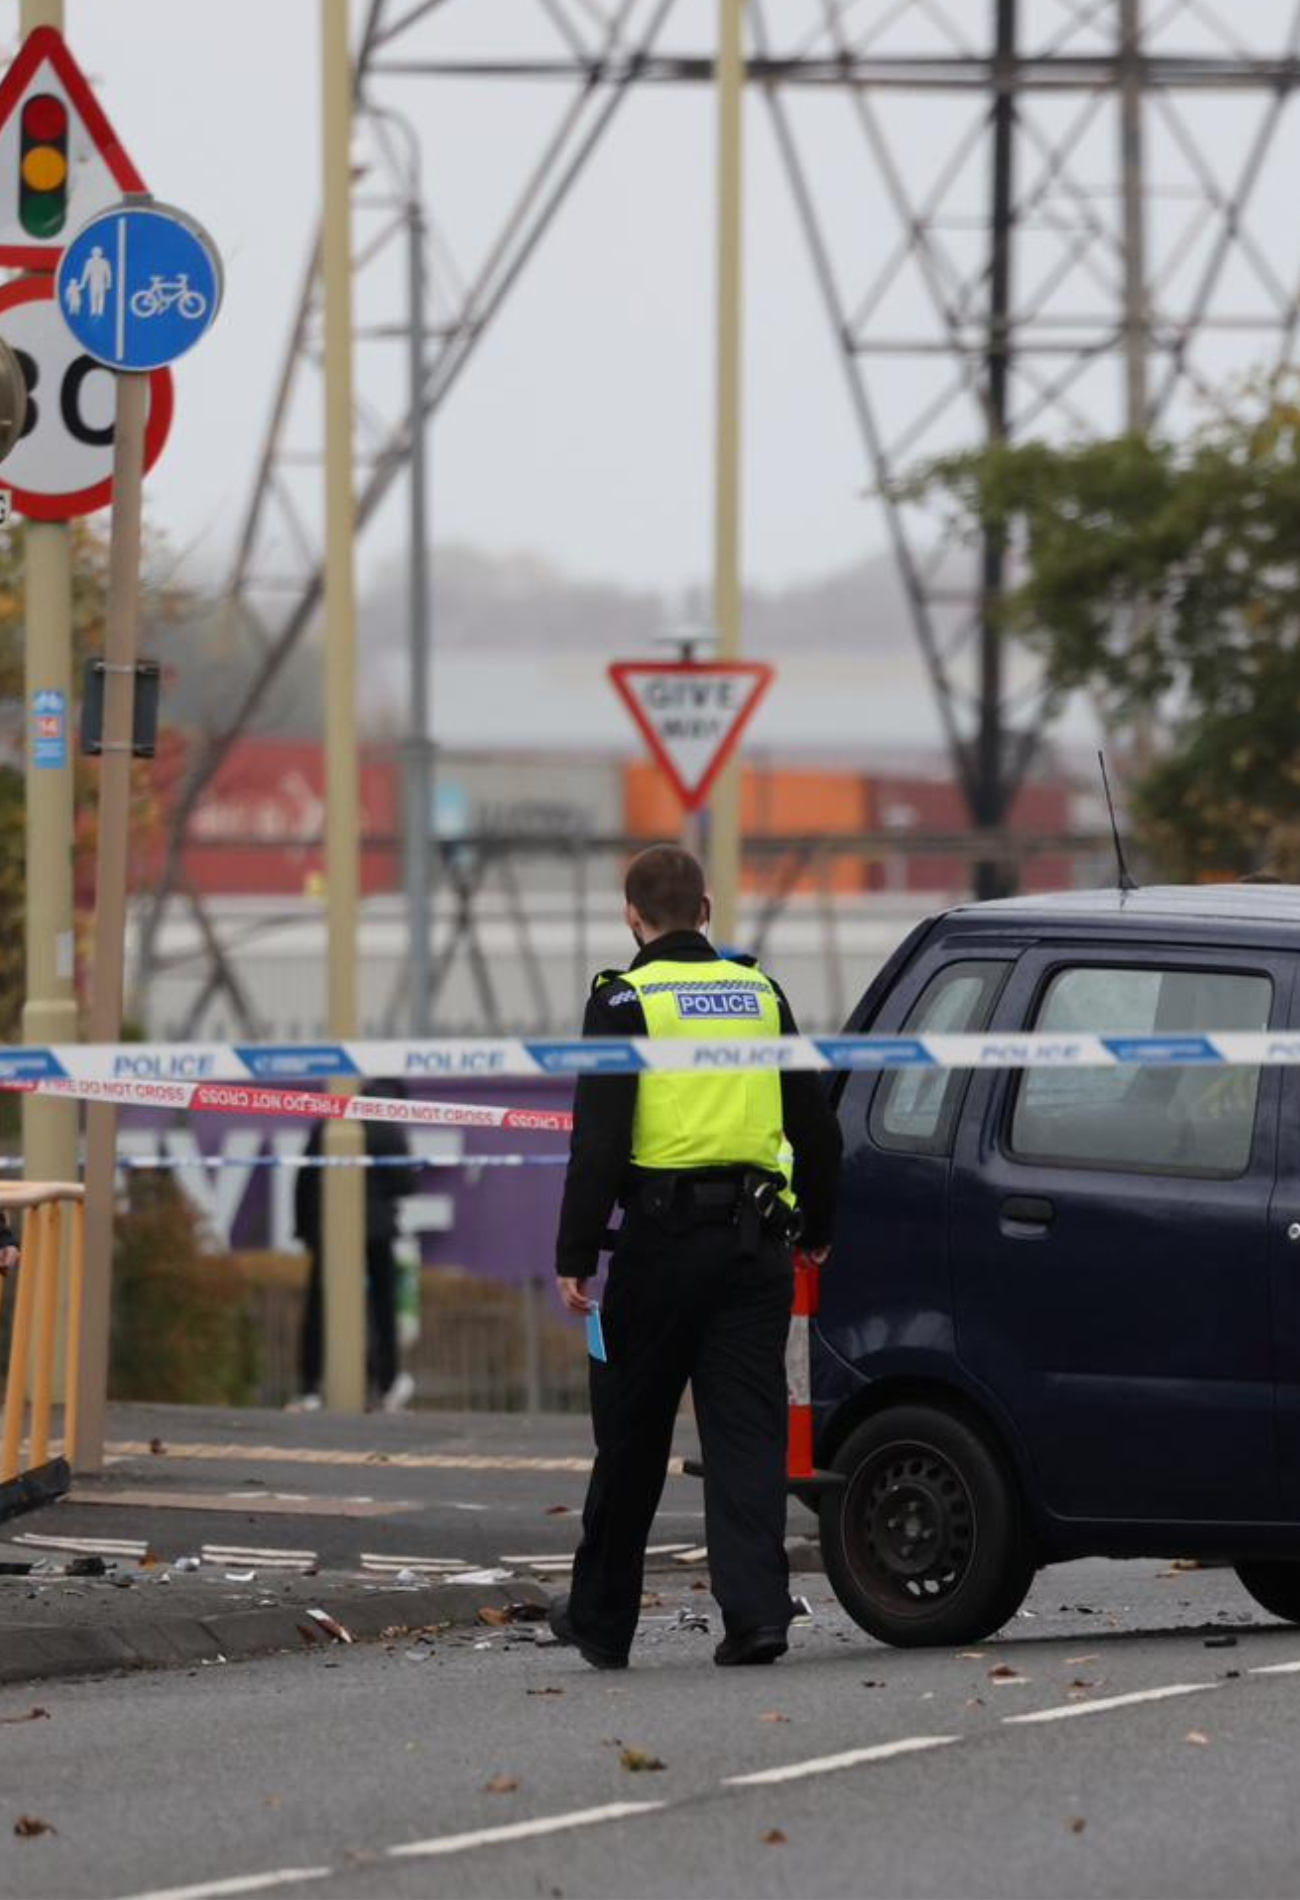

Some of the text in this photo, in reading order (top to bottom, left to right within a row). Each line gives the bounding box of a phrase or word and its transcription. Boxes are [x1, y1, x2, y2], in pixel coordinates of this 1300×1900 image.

[646, 680, 734, 708] GIVE
[679, 994, 758, 1013] POLICE
[114, 1054, 215, 1077] POLICE
[406, 1051, 504, 1070] POLICE
[694, 1046, 794, 1066] POLICE
[981, 1043, 1080, 1060] POLICE
[102, 1081, 132, 1097] NOT
[135, 1084, 186, 1101] CROSS
[199, 1087, 248, 1106] CROSS
[250, 1092, 281, 1108] NOT
[411, 1105, 441, 1120] NOT
[444, 1107, 494, 1124] CROSS
[507, 1112, 559, 1130] CROSS
